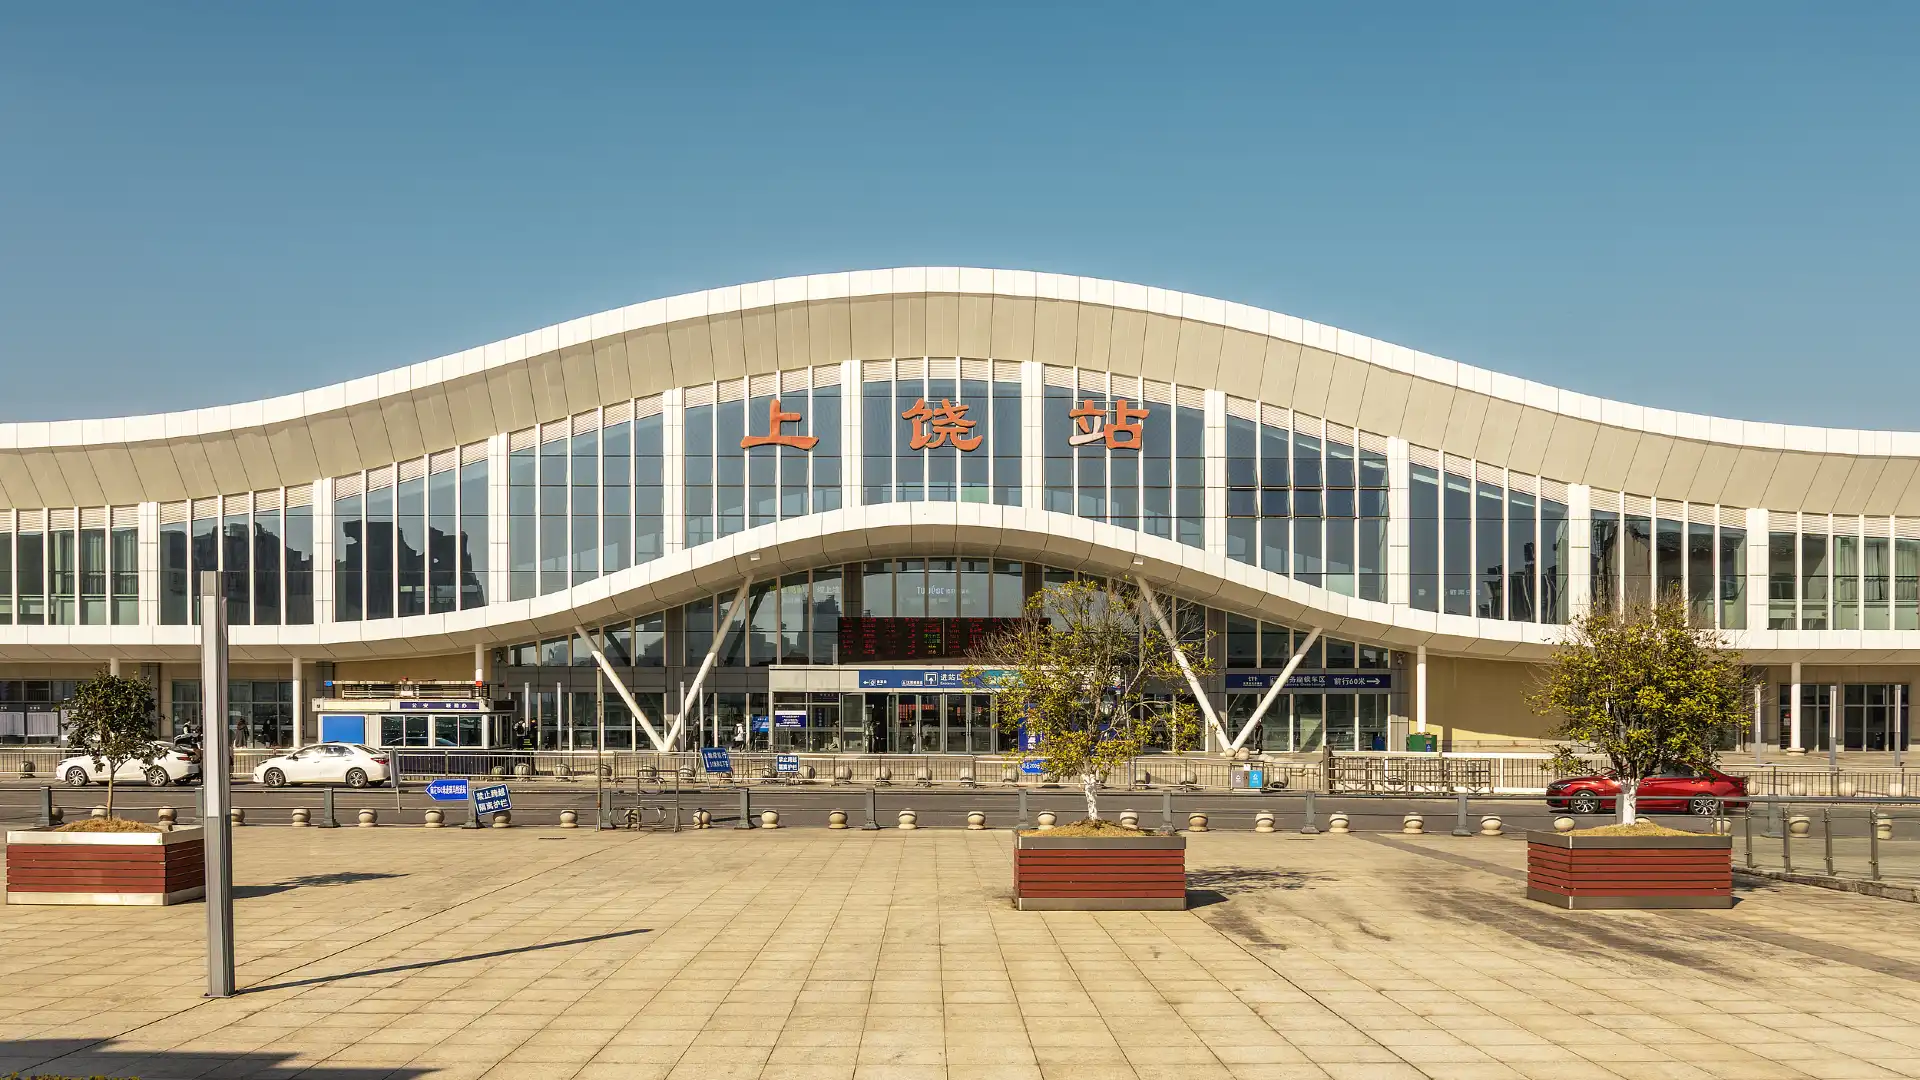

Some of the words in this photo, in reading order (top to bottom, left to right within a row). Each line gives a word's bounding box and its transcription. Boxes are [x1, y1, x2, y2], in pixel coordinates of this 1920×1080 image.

[741, 398, 1151, 452] 上饶站
[940, 673, 963, 681] 进站口
[1333, 677, 1366, 685] 前行60米
[476, 788, 506, 801] 禁止跨越
[477, 799, 509, 812] 隔离护栏
